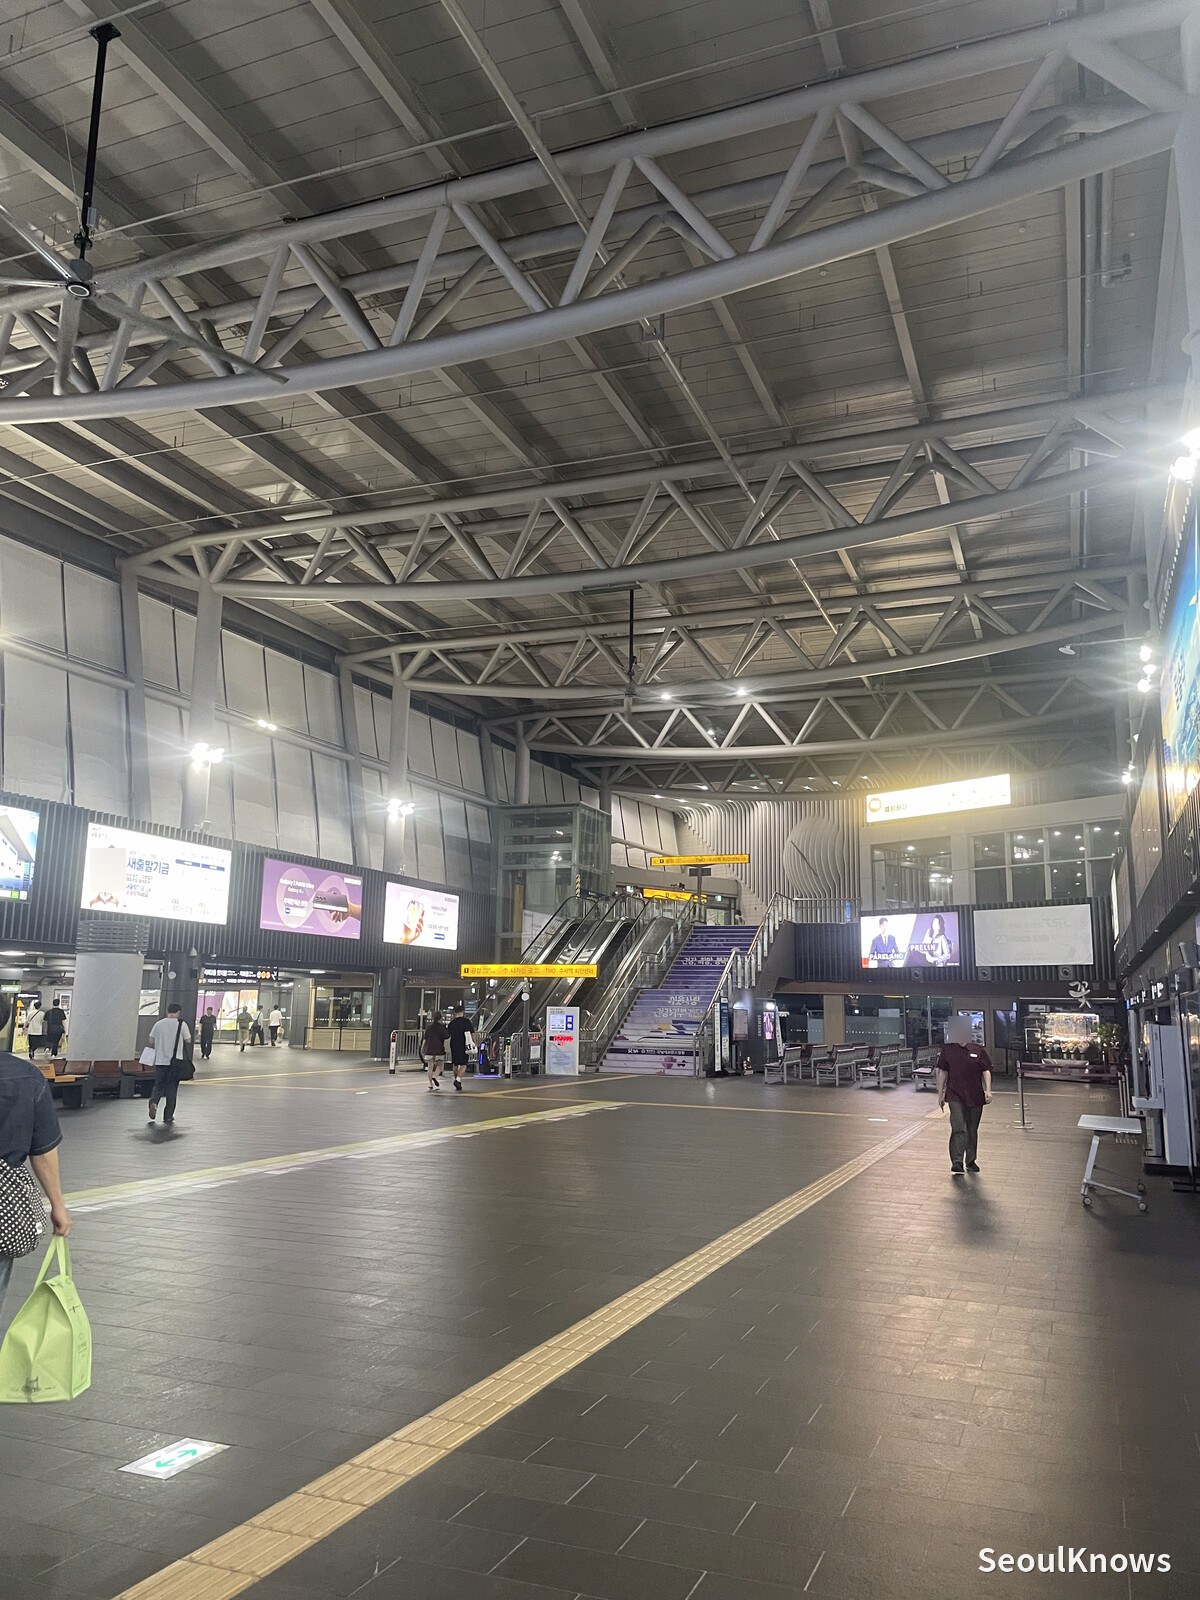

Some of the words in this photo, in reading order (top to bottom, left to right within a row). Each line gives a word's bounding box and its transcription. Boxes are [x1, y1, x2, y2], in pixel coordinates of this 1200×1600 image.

[126, 856, 170, 875] 새출발기금
[910, 943, 936, 952] PRELIN
[869, 951, 904, 961] PARKLAND
[667, 995, 701, 1005] 이웃사랑
[1068, 981, 1092, 1009] 꽃
